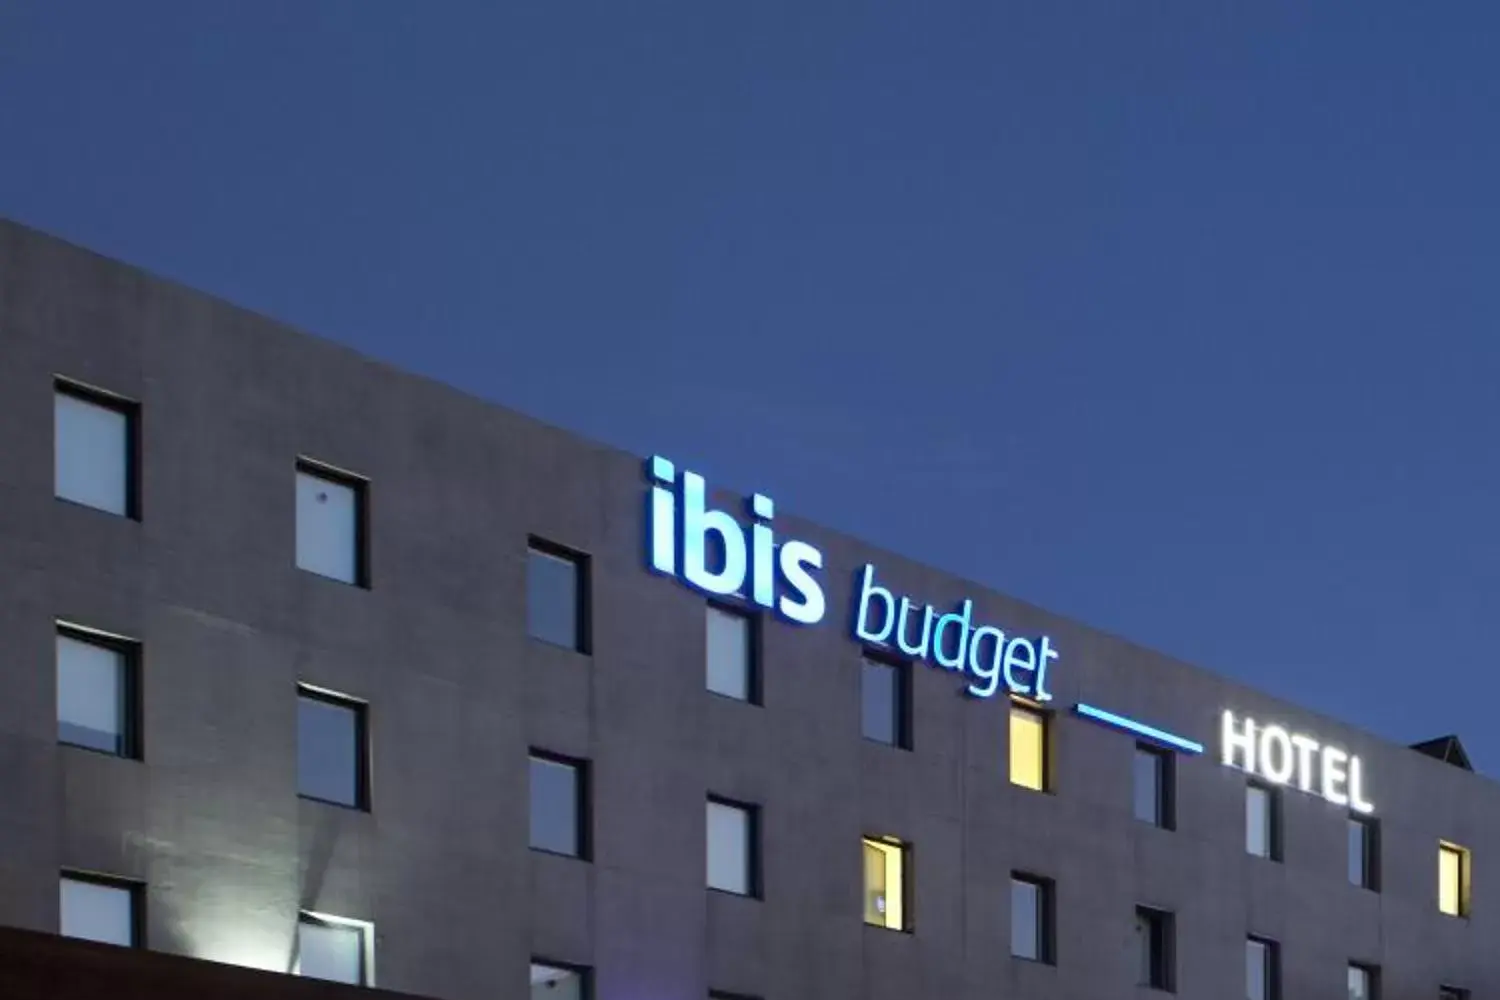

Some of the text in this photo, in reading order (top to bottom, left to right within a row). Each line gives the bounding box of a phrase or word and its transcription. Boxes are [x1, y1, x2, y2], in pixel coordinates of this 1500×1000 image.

[648, 455, 1059, 702] ibis budget
[1220, 709, 1375, 813] HOTEL
